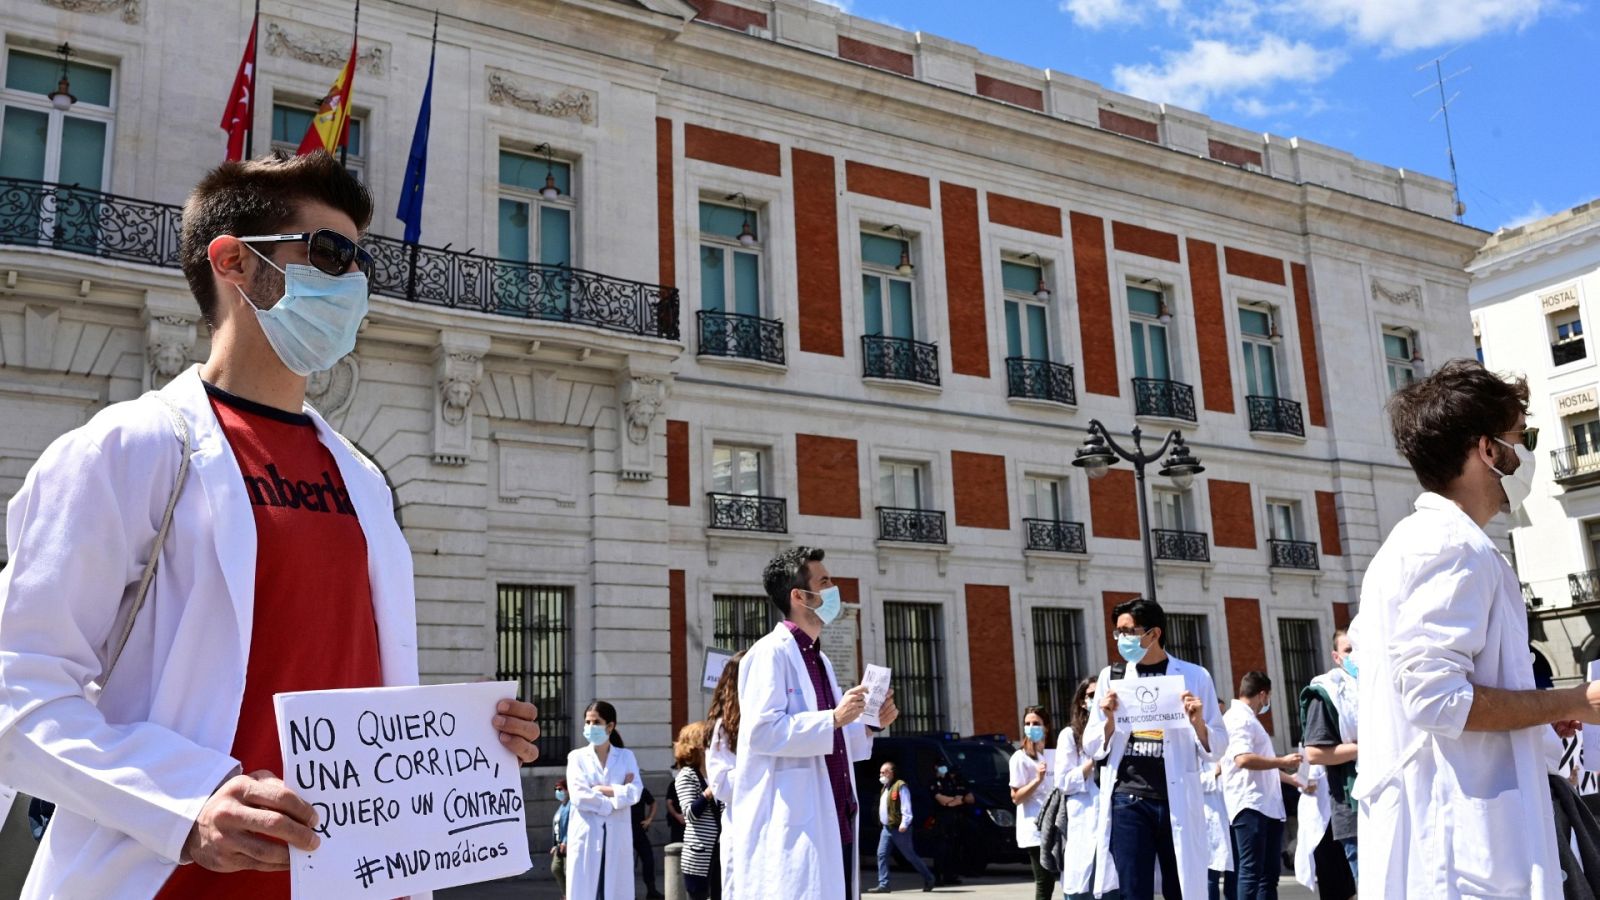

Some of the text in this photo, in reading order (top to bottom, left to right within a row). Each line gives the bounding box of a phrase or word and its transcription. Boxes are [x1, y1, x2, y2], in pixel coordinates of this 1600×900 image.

[1542, 290, 1576, 309] HOSTAL
[1559, 392, 1594, 410] HOSTAL
[1117, 713, 1185, 723] #MEDICOSDICENBASTA
[289, 710, 456, 756] NO QUIERO
[1124, 741, 1165, 758] GENIU
[295, 746, 500, 791] UNA CORRIDA,
[311, 788, 523, 839] QUIERO UN CONTRATO
